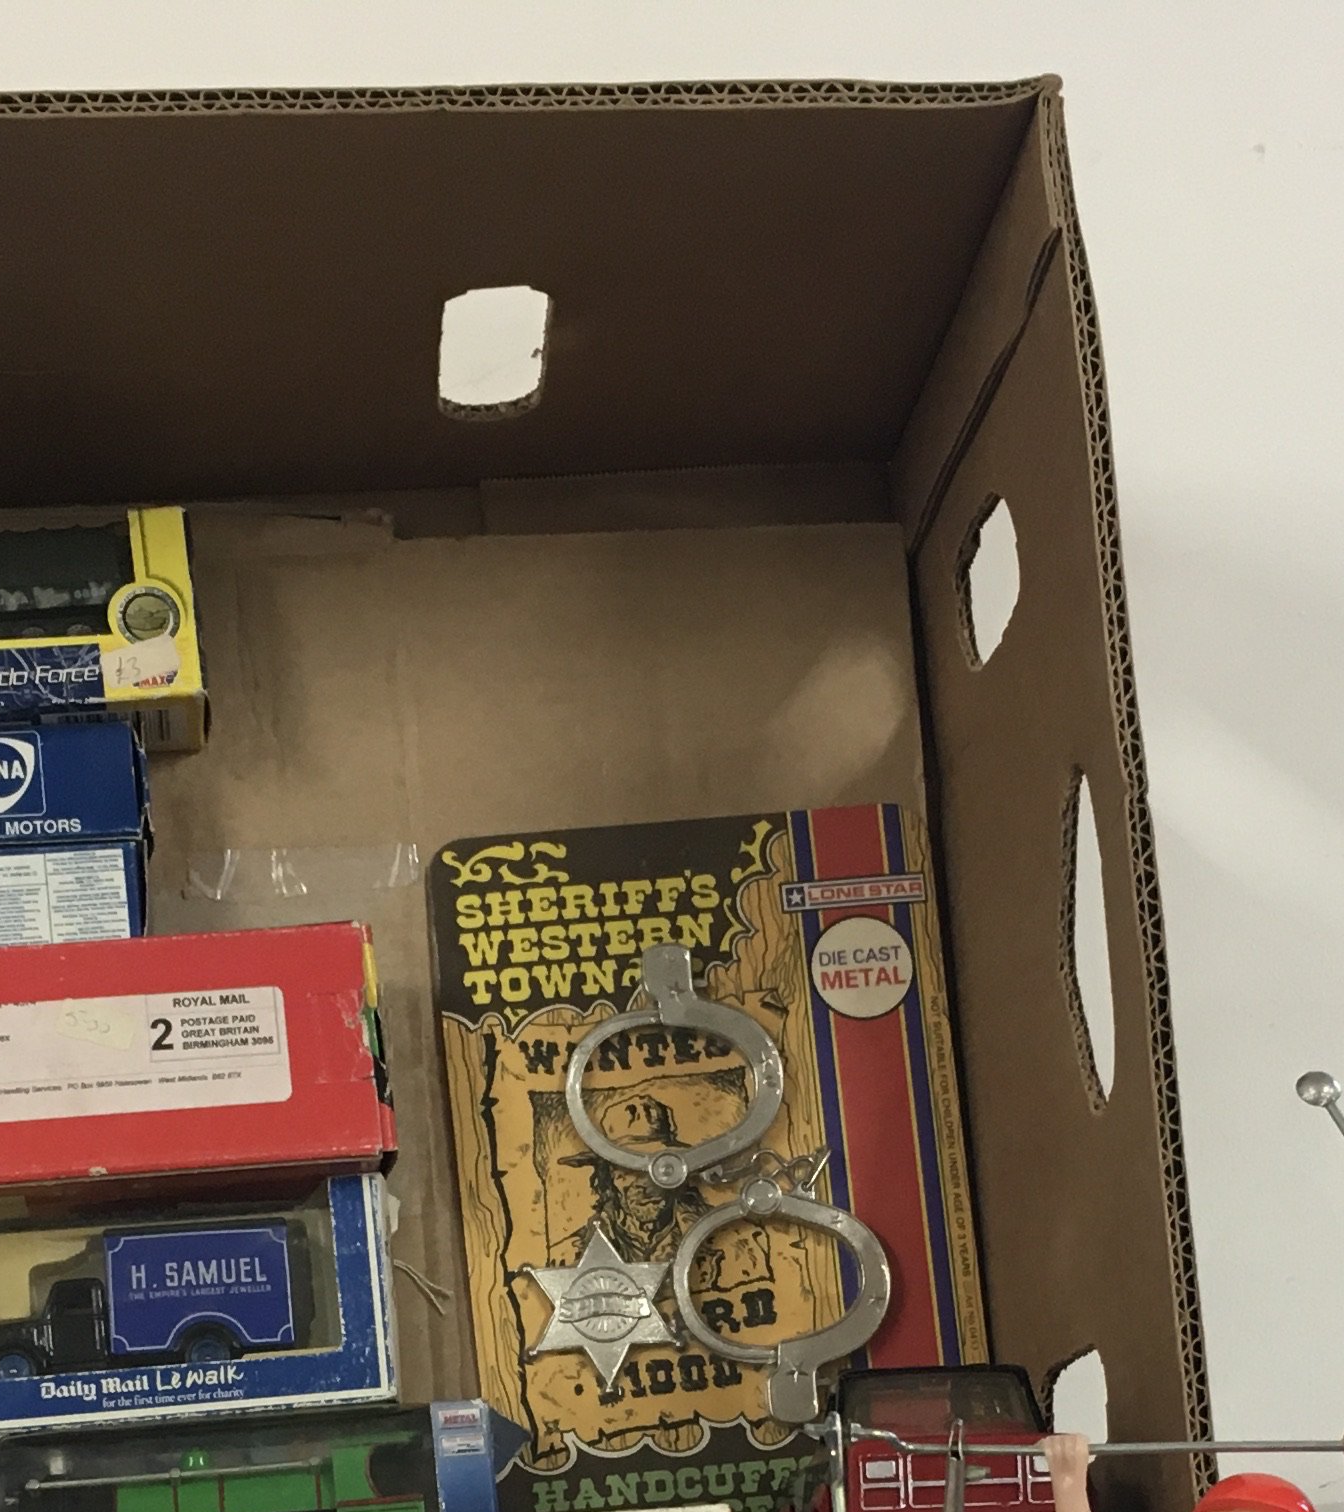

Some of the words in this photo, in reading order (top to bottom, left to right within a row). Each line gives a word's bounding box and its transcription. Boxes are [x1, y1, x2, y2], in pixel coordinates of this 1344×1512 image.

[35, 665, 100, 685] Force
[5, 818, 82, 837] MOTORS
[455, 869, 721, 930] SHERIFF'S
[808, 885, 865, 902] LONE
[868, 881, 923, 897] STAR
[459, 912, 715, 967] WESTERN
[818, 950, 848, 968] DIE
[852, 945, 902, 964] CAST
[463, 959, 618, 1005] TOWN
[820, 965, 907, 992] METAL
[172, 995, 216, 1008] ROYAL
[219, 993, 250, 1005] MAIL
[180, 1015, 229, 1028] POSTAGE
[232, 1013, 256, 1024] PAID
[181, 1027, 216, 1039] GREAT
[219, 1025, 260, 1037] BRITAIN
[150, 1017, 174, 1052] 2
[182, 1038, 249, 1050] BIRMINGHAM
[940, 1074, 950, 1095] FOR
[949, 1152, 961, 1193] UNDER
[958, 1243, 972, 1278] YEARS
[165, 1257, 268, 1287] SAMUEL
[40, 1381, 97, 1401] Daily
[100, 1375, 150, 1394] Mail
[102, 1396, 115, 1408] for
[117, 1394, 133, 1406] the
[134, 1394, 154, 1406] first
[155, 1392, 175, 1404] time
[177, 1391, 196, 1402] ever
[198, 1389, 211, 1400] for
[213, 1386, 245, 1400] charity
